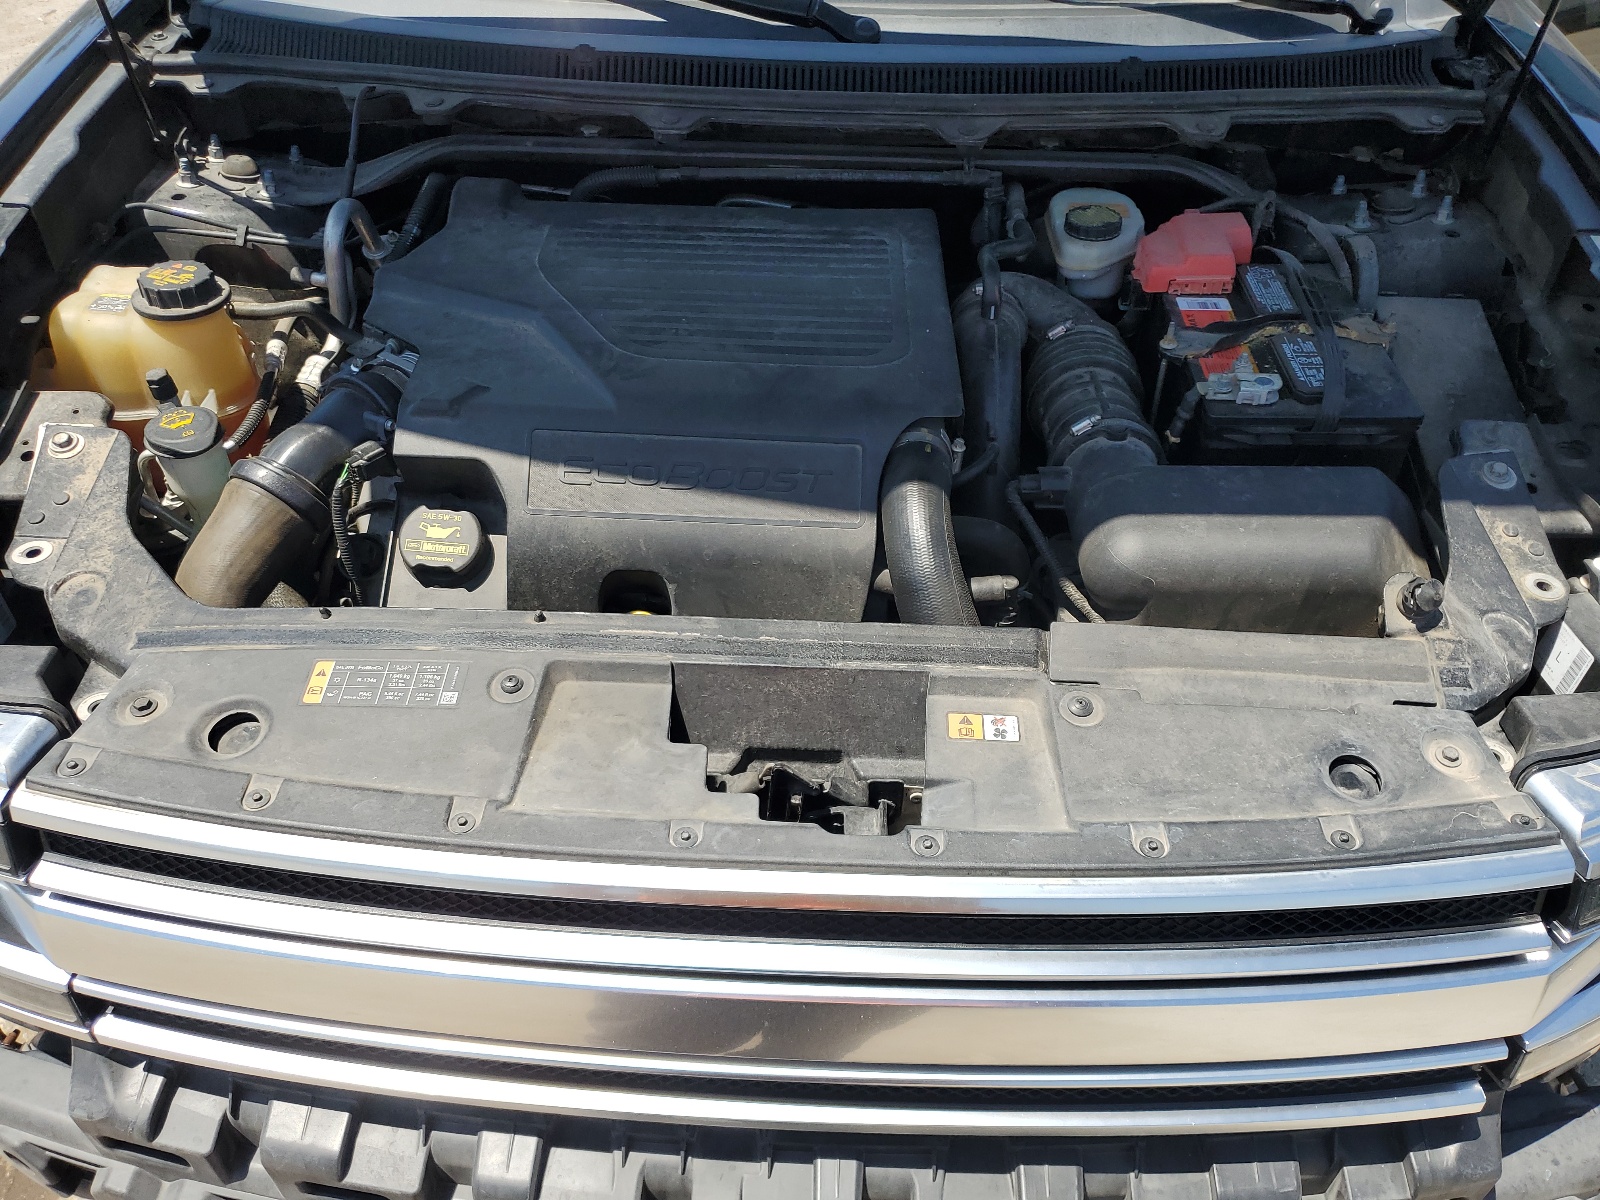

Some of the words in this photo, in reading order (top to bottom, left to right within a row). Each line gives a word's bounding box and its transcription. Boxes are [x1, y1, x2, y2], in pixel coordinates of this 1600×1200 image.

[422, 512, 437, 520] SAE
[437, 513, 462, 522] 5W-30
[422, 542, 467, 553] Motorcraft
[415, 554, 454, 562] Recommended
